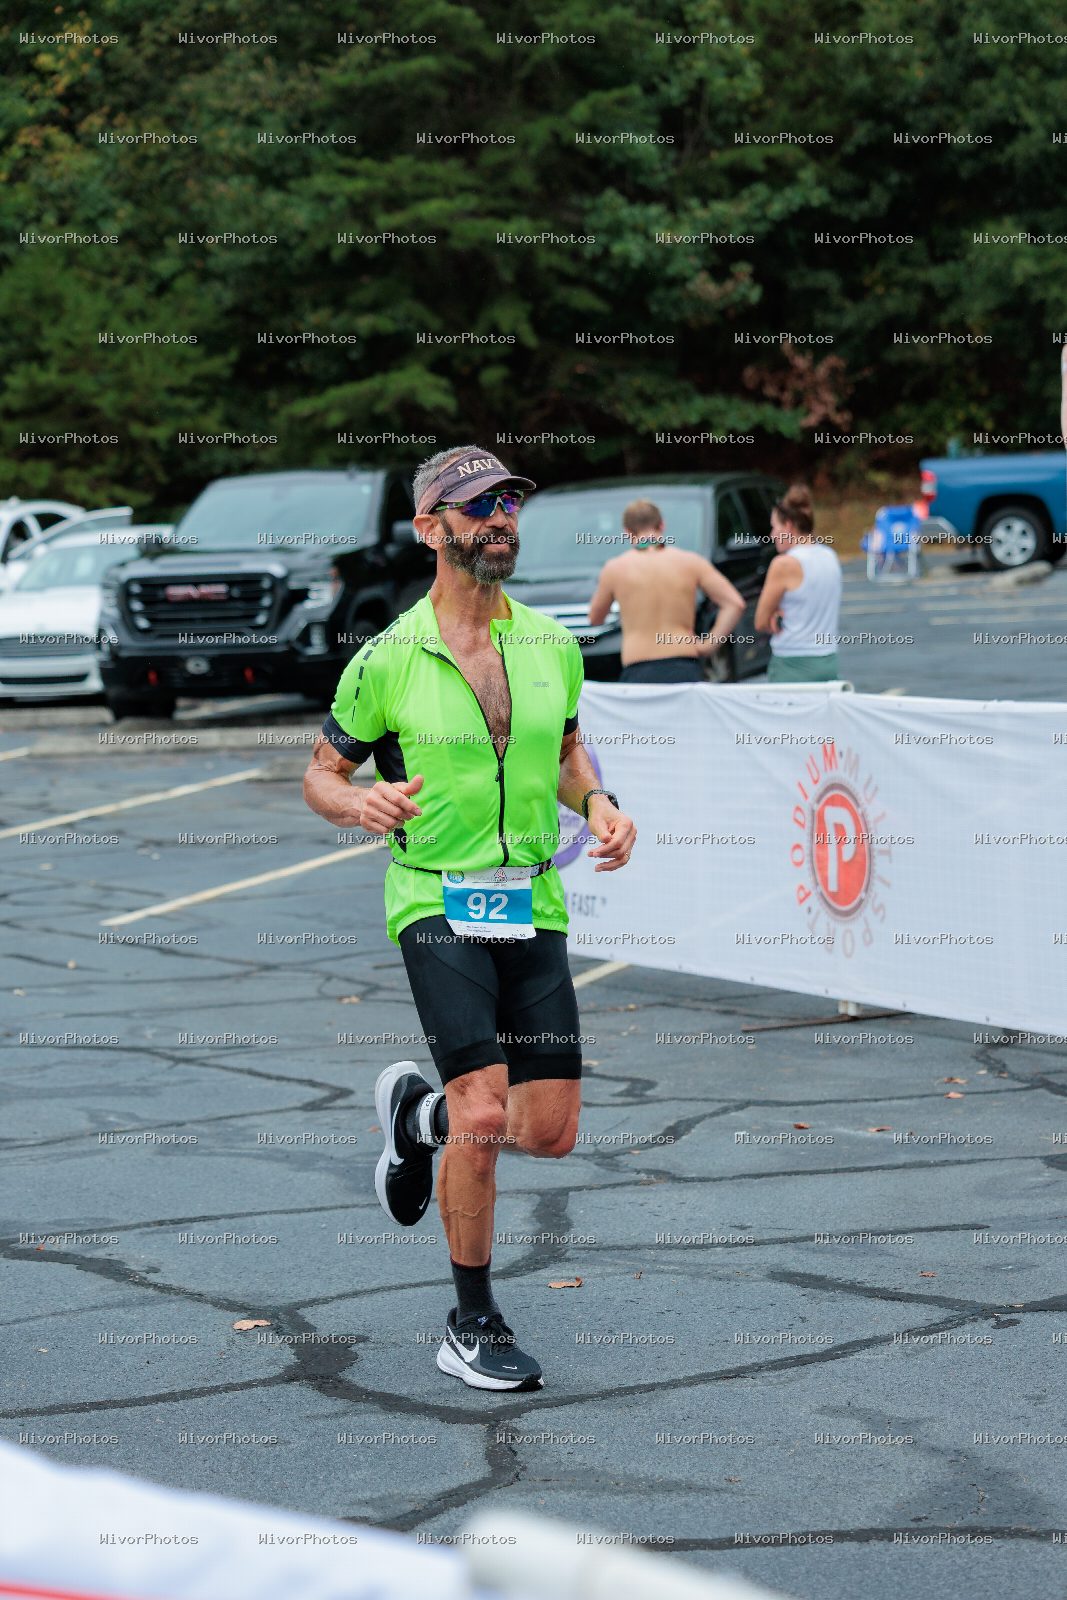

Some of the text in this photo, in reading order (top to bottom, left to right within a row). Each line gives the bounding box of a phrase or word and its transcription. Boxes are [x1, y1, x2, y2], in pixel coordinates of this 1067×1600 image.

[457, 458, 505, 478] NAVY
[790, 742, 838, 905] PODIUM
[824, 805, 857, 893] P
[466, 892, 509, 920] 92
